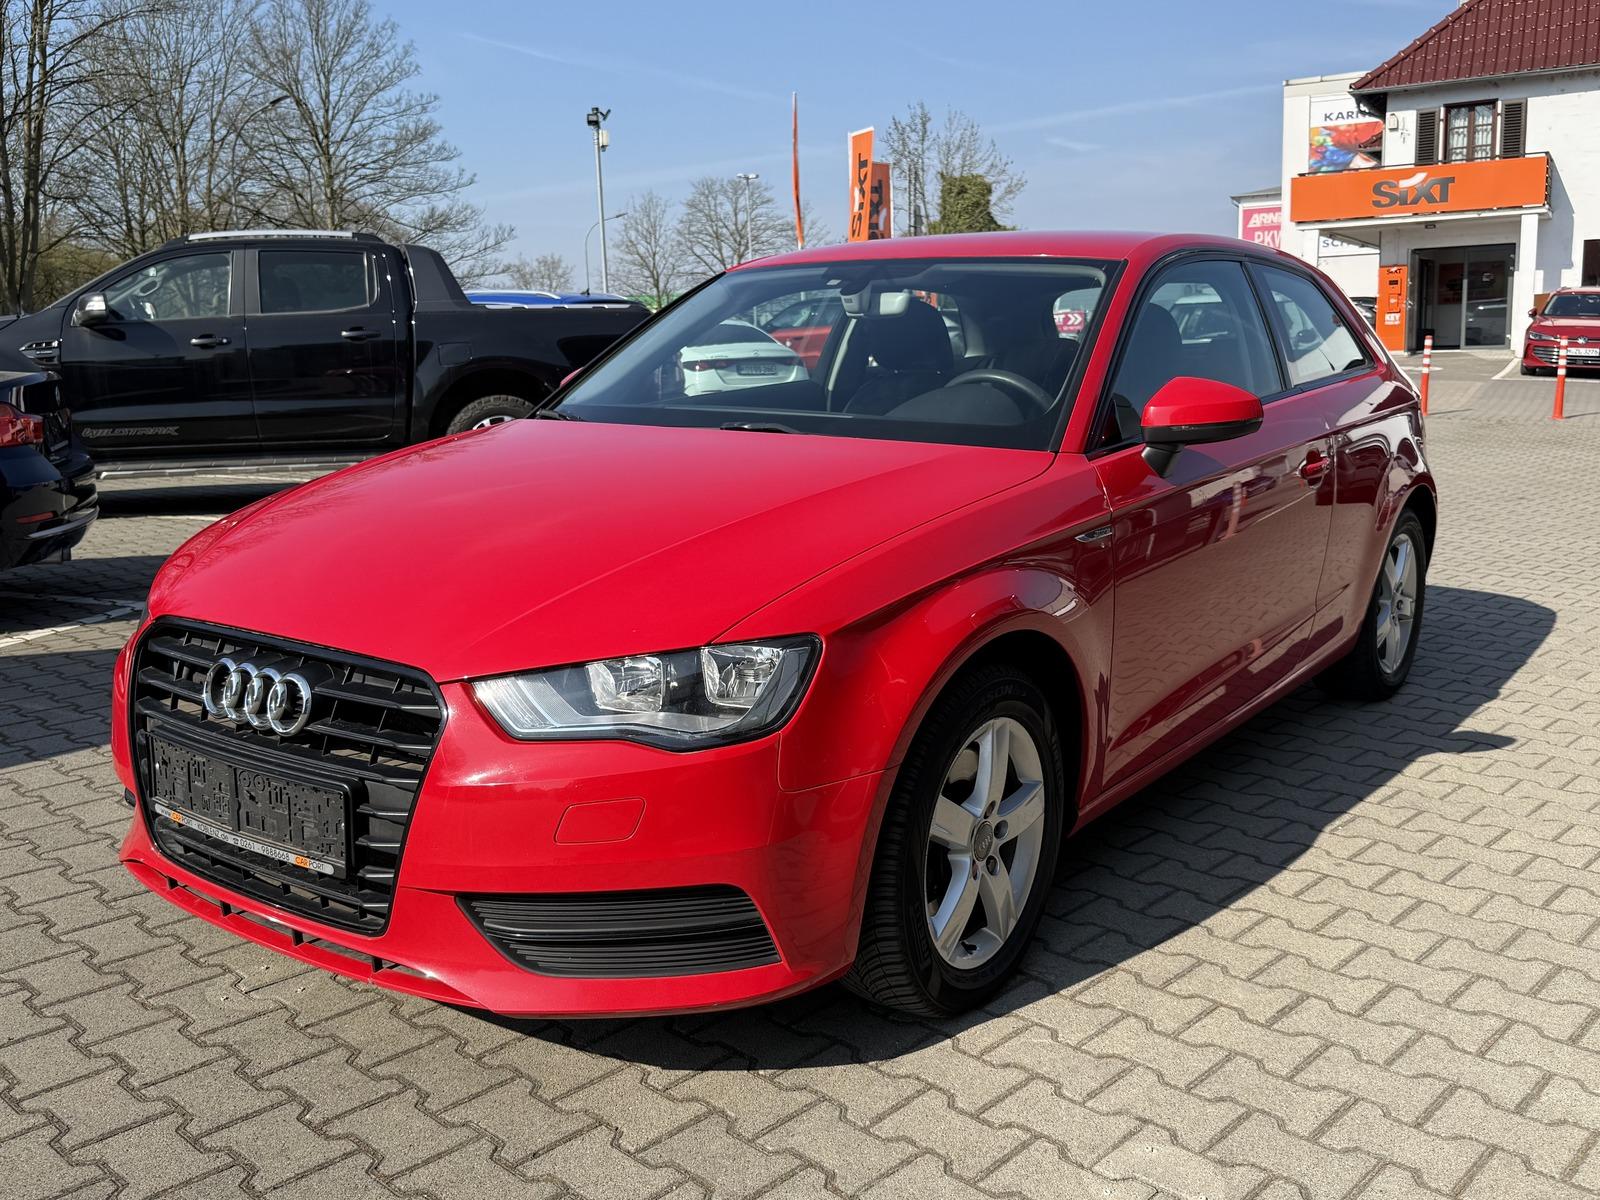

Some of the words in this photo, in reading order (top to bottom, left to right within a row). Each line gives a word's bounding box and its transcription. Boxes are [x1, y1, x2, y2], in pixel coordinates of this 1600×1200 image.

[852, 152, 868, 238] SIXT
[1371, 172, 1455, 208] SIXT
[294, 856, 325, 871] CARPORT
